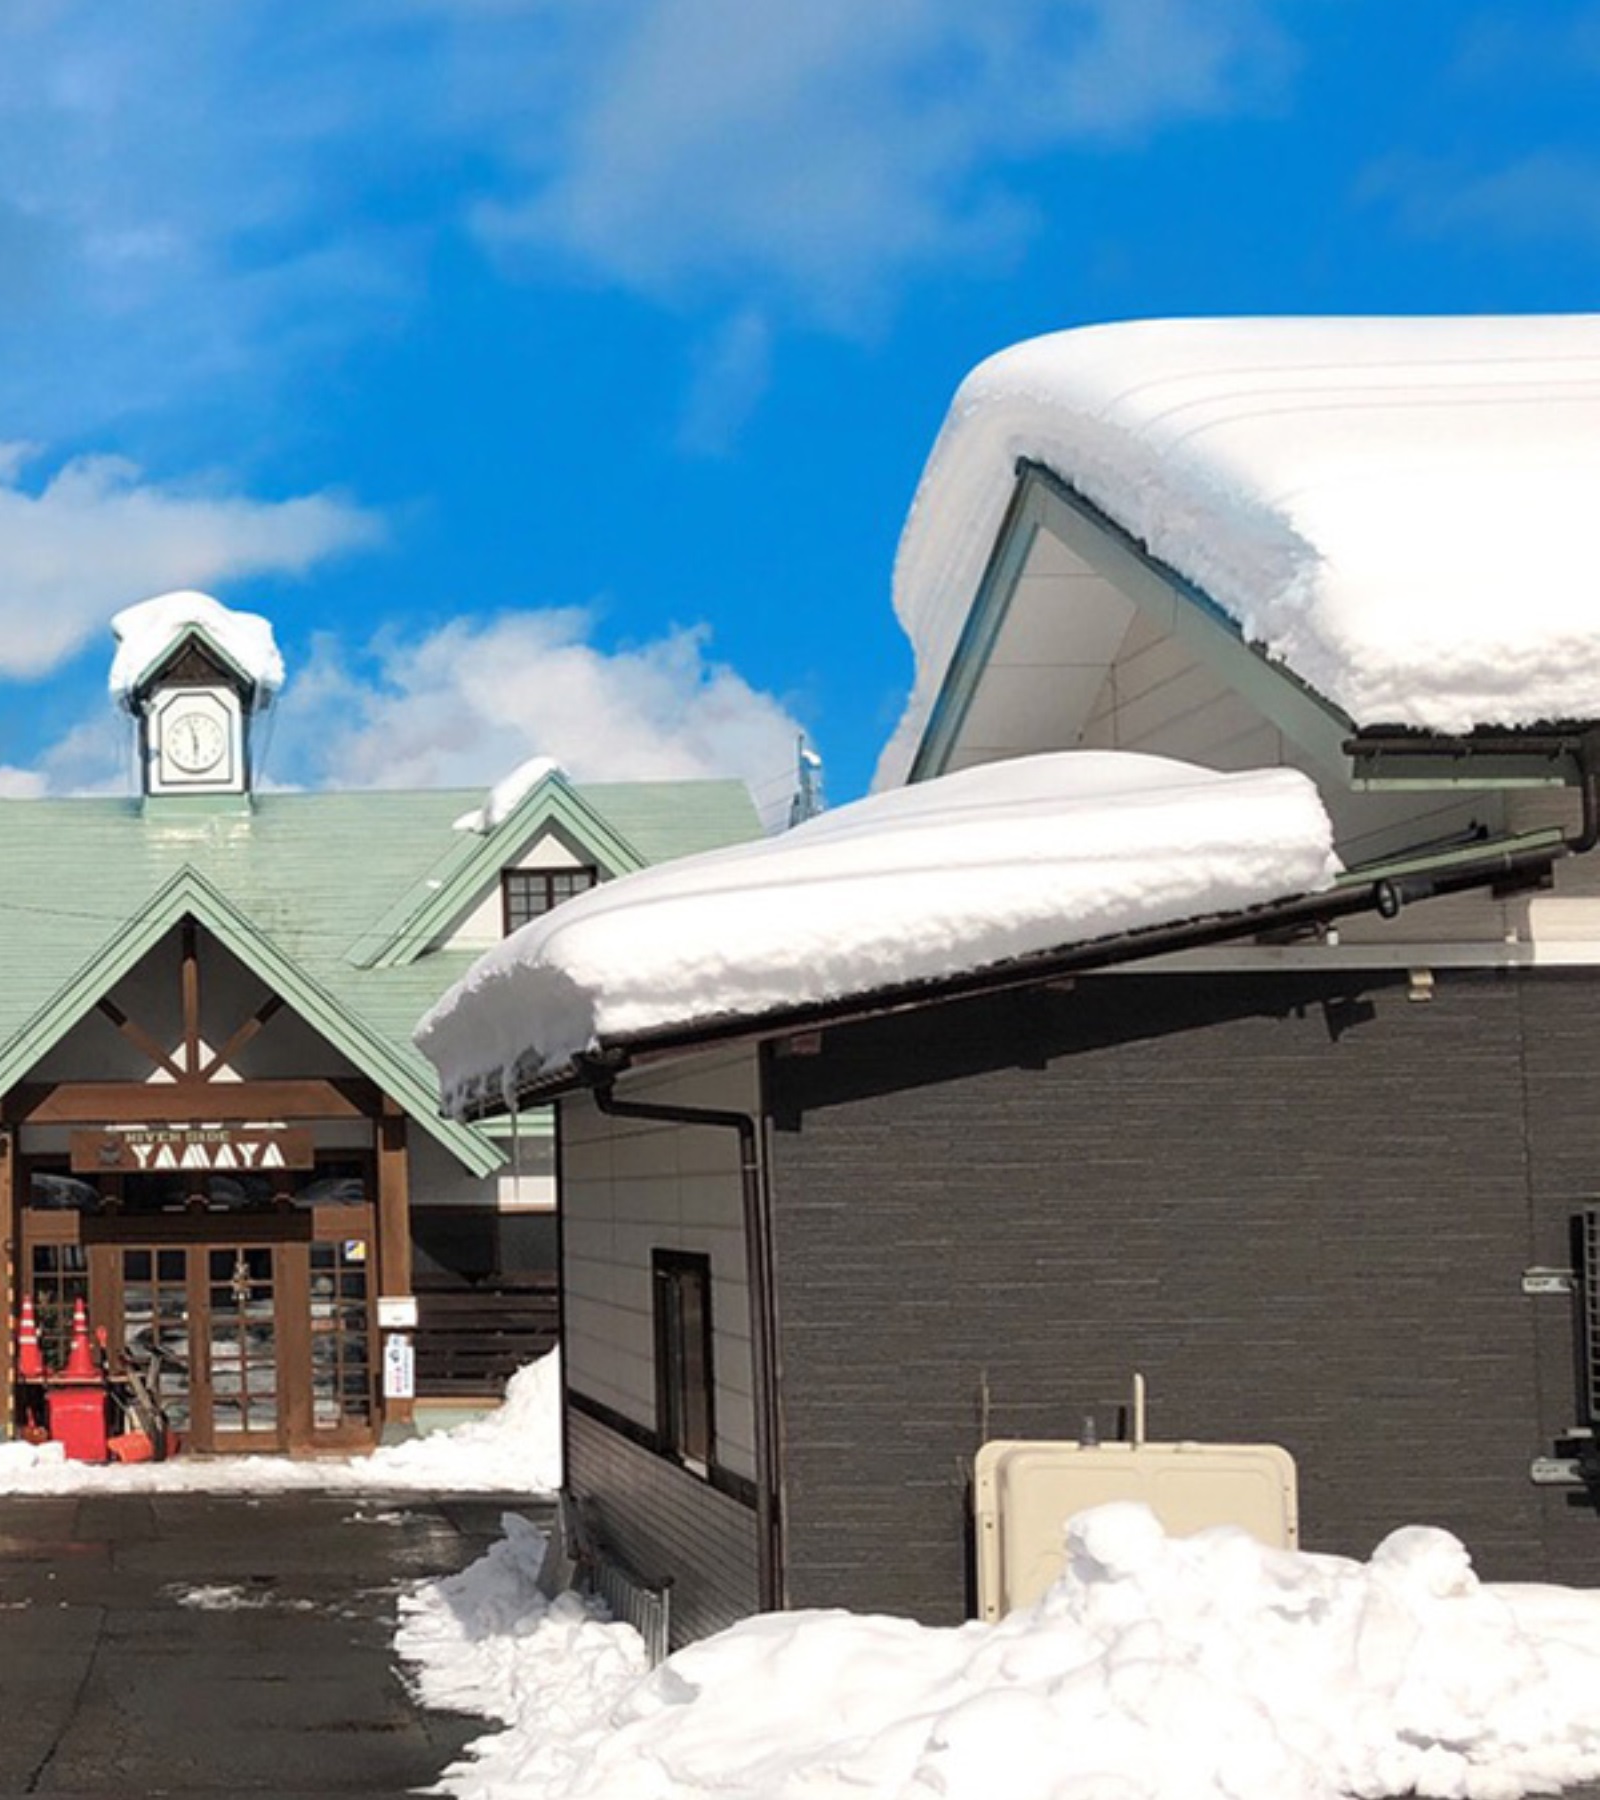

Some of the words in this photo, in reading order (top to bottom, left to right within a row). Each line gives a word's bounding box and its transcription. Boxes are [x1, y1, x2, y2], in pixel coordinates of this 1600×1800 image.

[125, 1131, 181, 1143] RIVER
[186, 1131, 229, 1143] SIDE
[131, 1143, 286, 1169] YAMAYA
